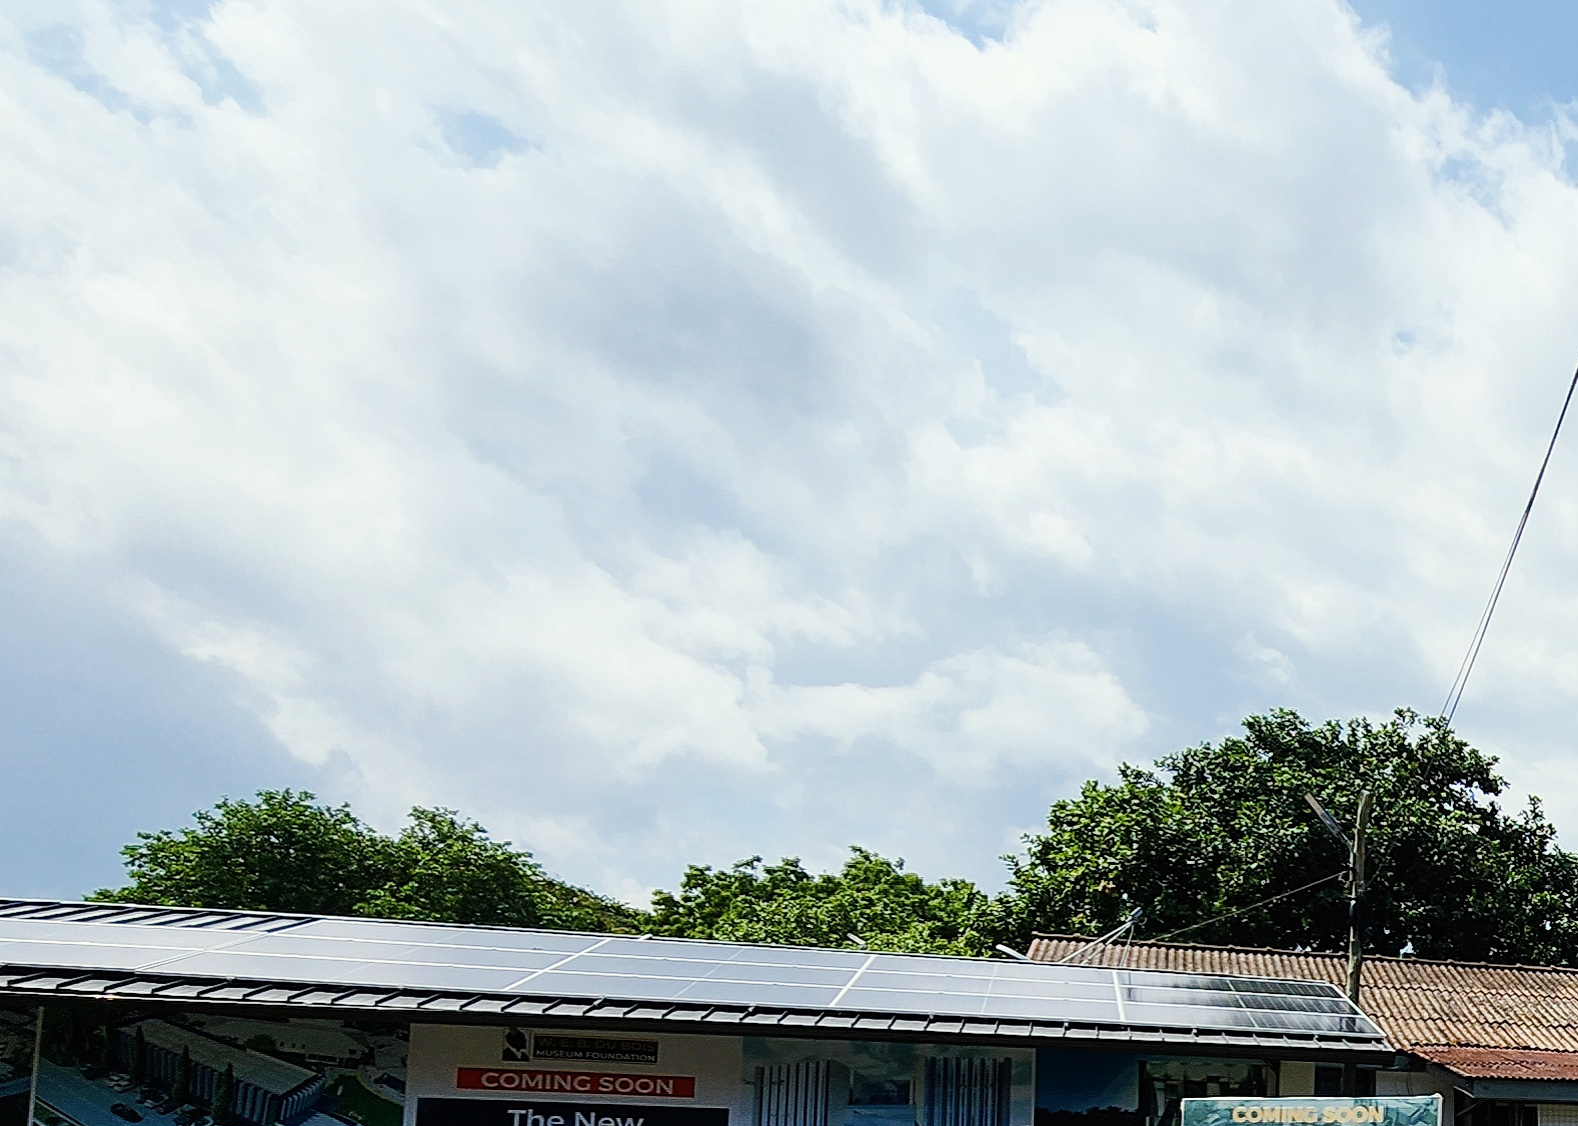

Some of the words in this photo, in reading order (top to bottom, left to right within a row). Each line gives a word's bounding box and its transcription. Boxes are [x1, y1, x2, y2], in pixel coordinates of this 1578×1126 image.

[621, 1041, 656, 1052] BOIS
[536, 1050, 583, 1058] MUSEUM
[585, 1052, 656, 1062] FOUNDATION
[480, 1072, 592, 1092] COMING
[598, 1077, 674, 1095] SOON
[1232, 1106, 1318, 1123] COMING
[1322, 1106, 1385, 1123] SOON
